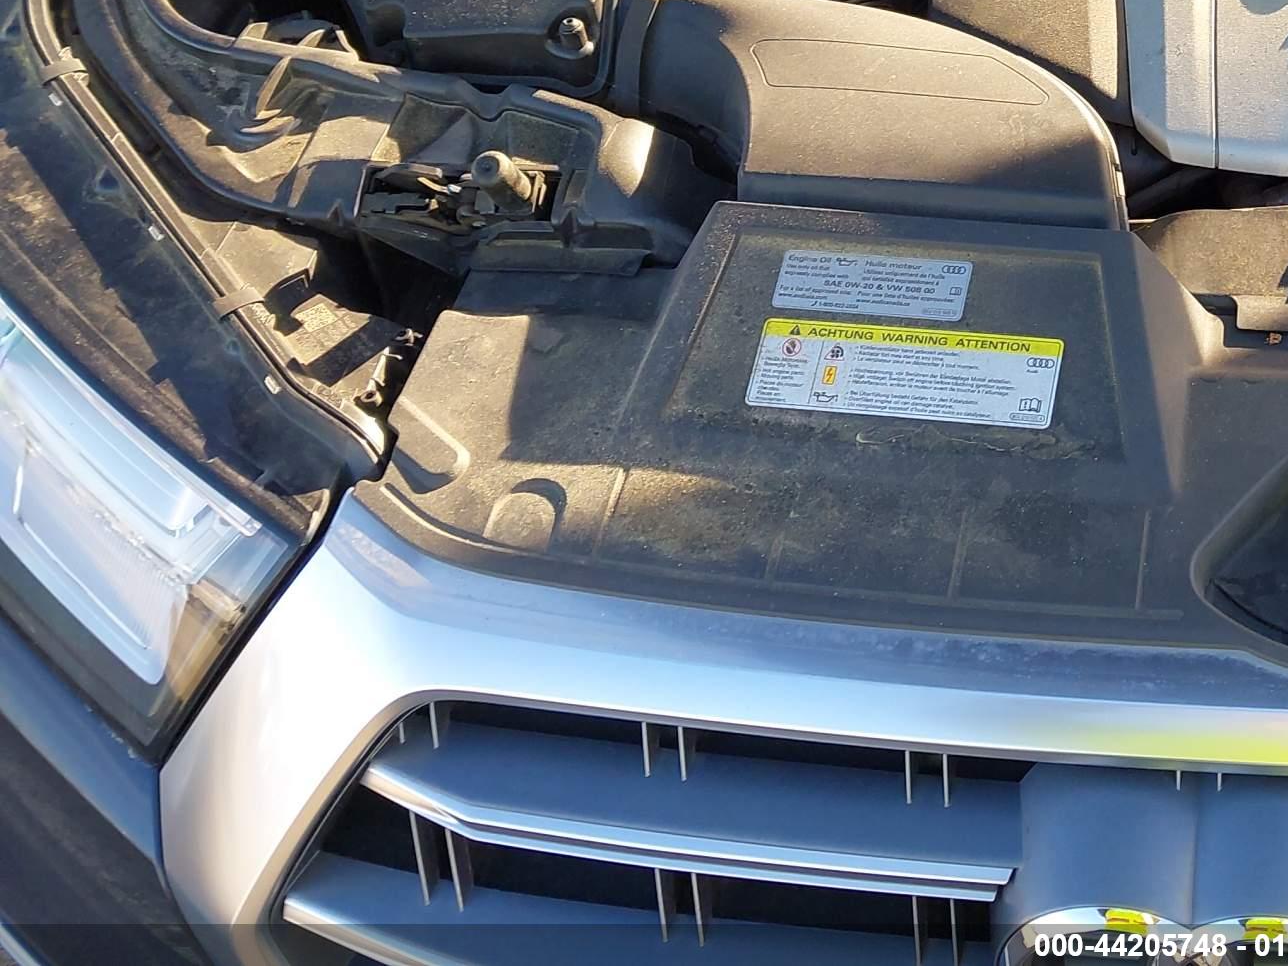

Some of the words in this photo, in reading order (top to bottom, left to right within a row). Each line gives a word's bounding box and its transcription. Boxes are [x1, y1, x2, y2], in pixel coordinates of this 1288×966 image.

[788, 253, 818, 263] Engine
[818, 255, 832, 263] Oil
[864, 259, 888, 268] Huile
[888, 262, 922, 270] moteur
[822, 279, 842, 288] SAE
[844, 281, 874, 290] 0W-20
[886, 283, 902, 292] VW
[923, 286, 935, 294] 00
[807, 327, 873, 340] ACHTUNG
[882, 333, 948, 346] WARNING
[955, 338, 1031, 352] ATTENTION
